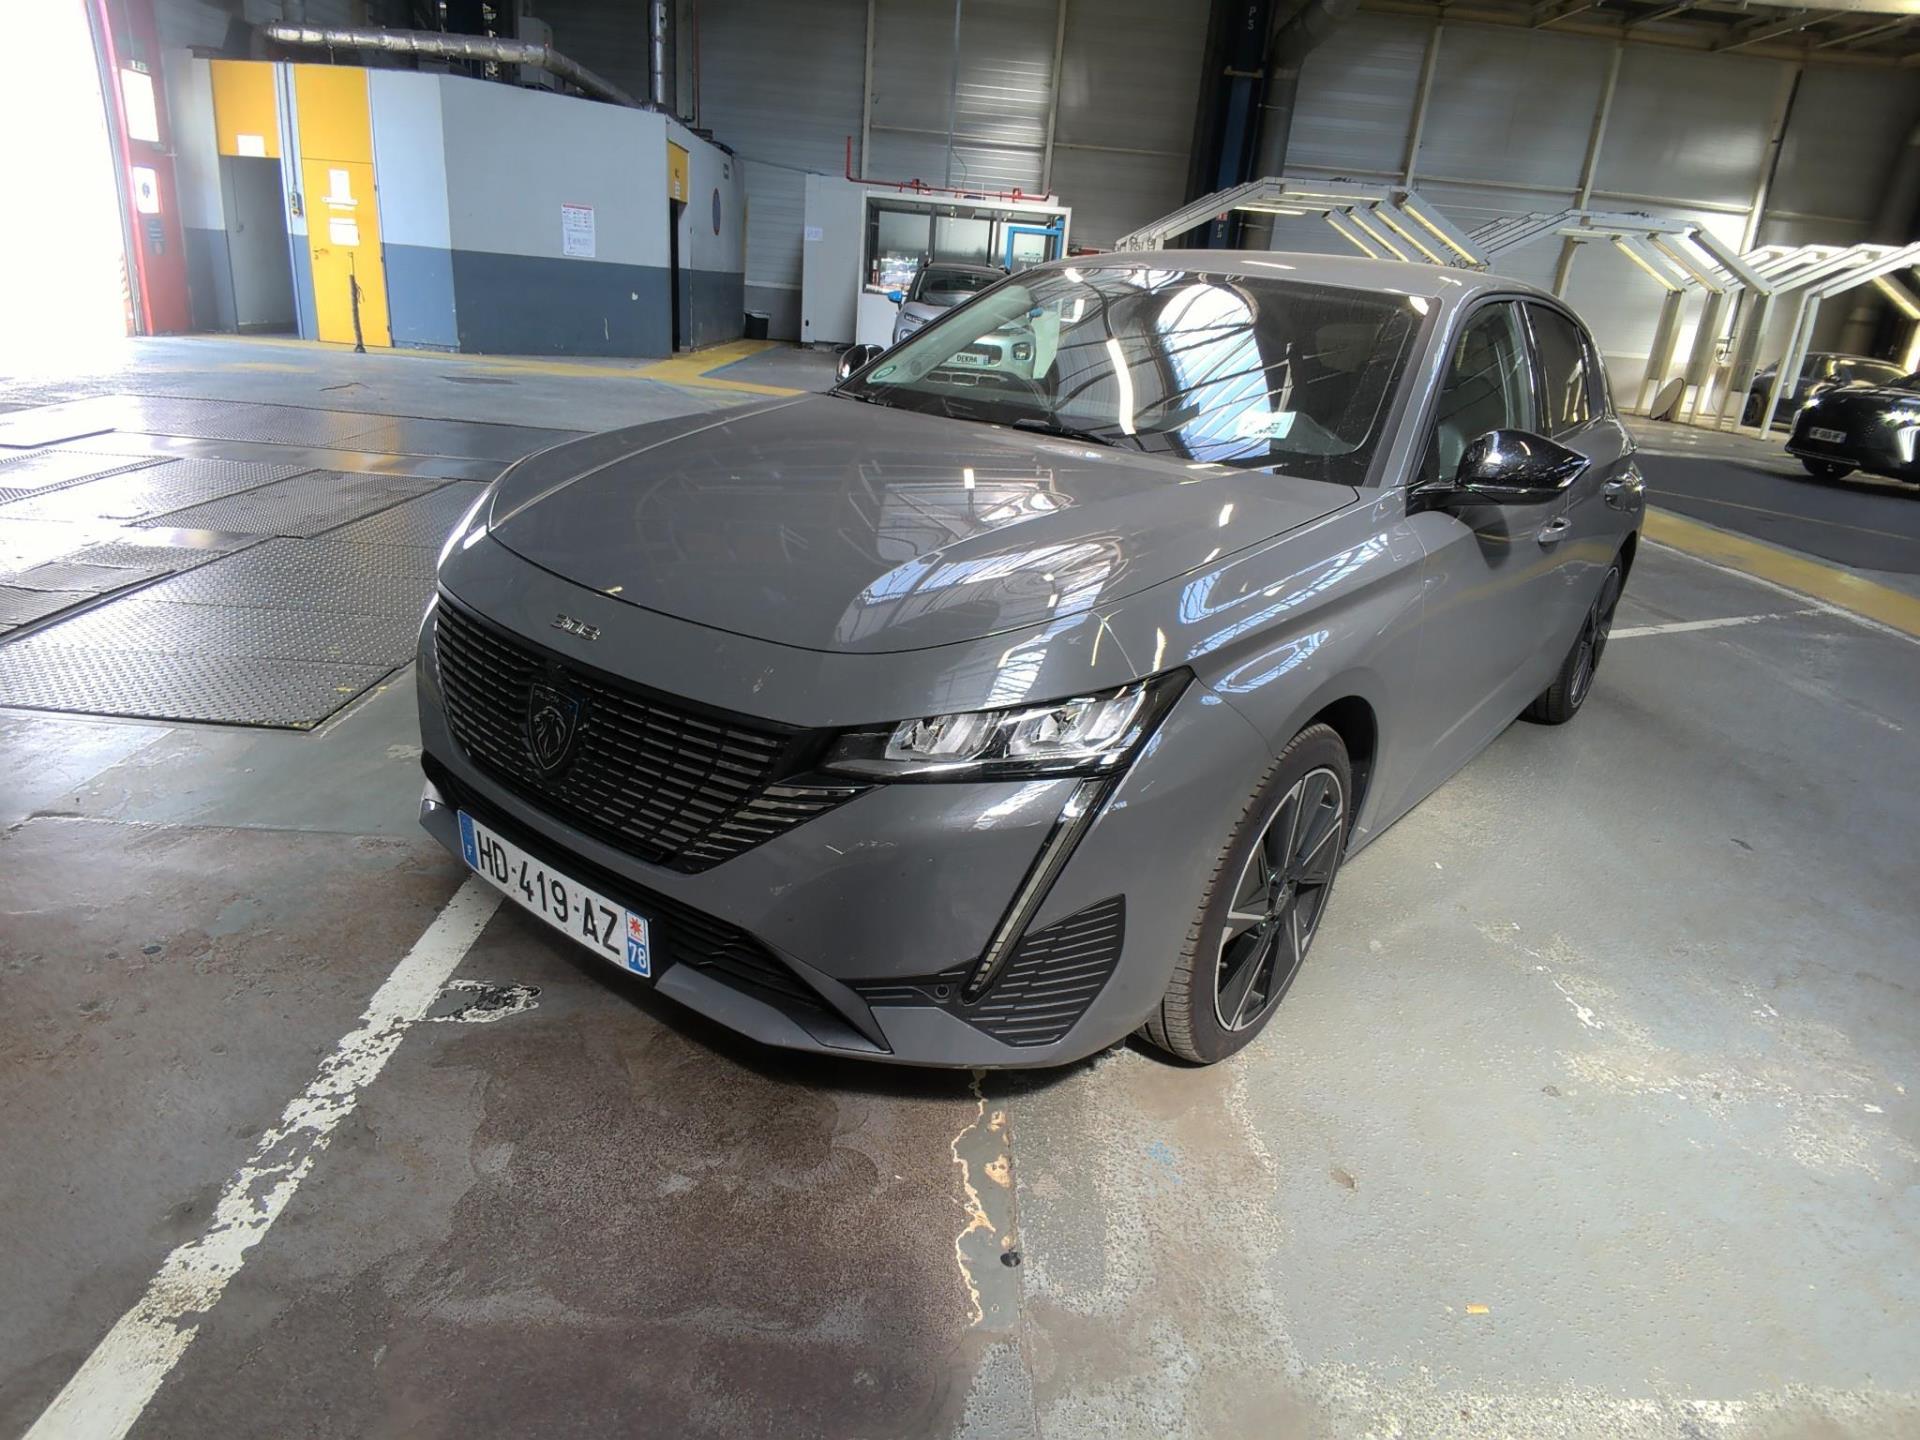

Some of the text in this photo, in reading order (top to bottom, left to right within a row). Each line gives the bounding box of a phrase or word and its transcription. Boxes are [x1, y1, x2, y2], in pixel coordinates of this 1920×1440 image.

[551, 613, 601, 641] 308
[476, 830, 621, 956] HD-419-AZ
[627, 941, 647, 970] 78
